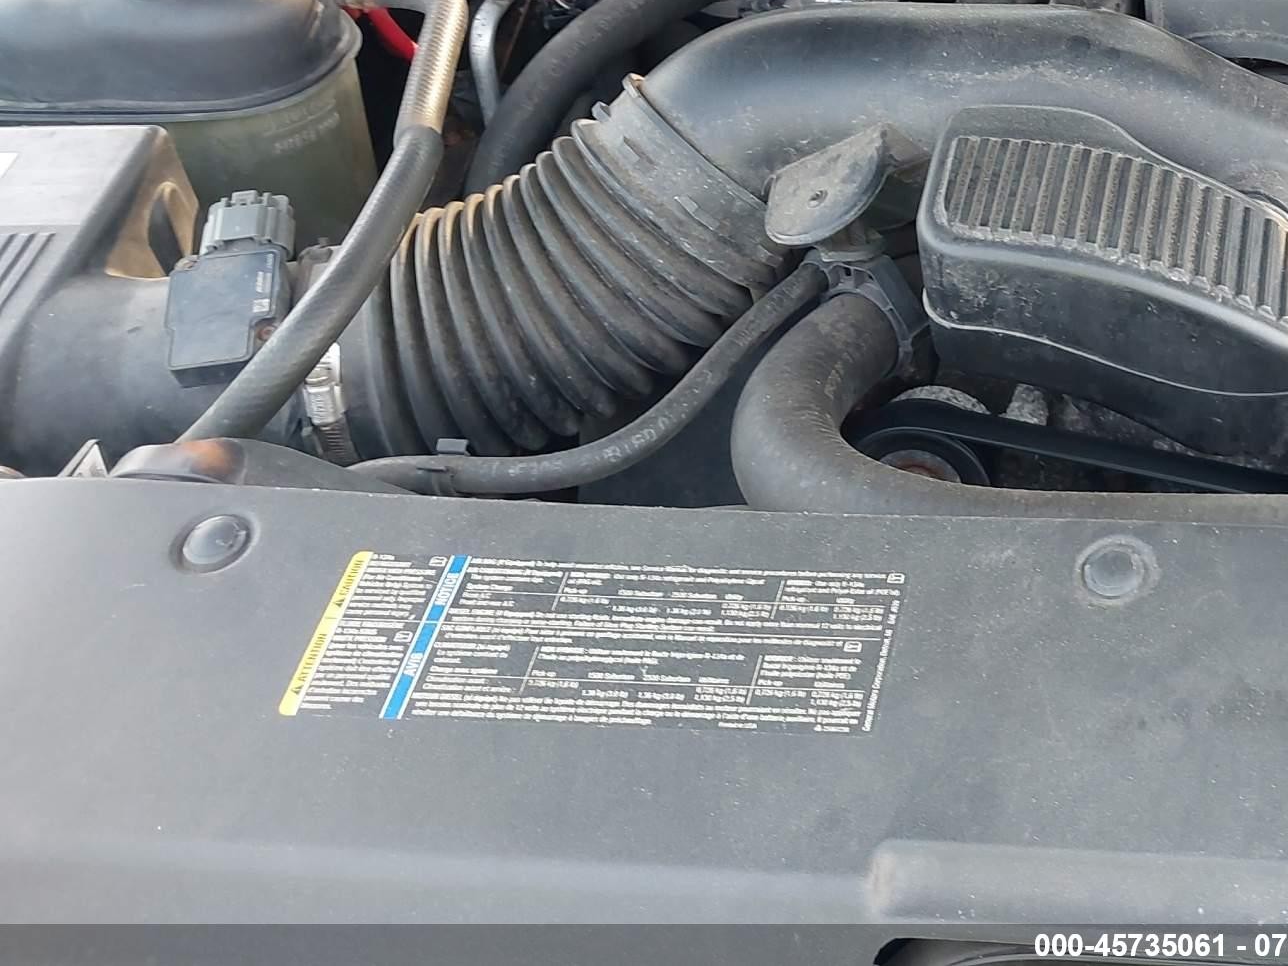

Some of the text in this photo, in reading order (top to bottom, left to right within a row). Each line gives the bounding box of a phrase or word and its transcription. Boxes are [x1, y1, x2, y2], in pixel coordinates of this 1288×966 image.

[339, 560, 364, 596] CAUTION
[434, 572, 460, 606] NOTICE
[298, 633, 327, 682] ATTENTION
